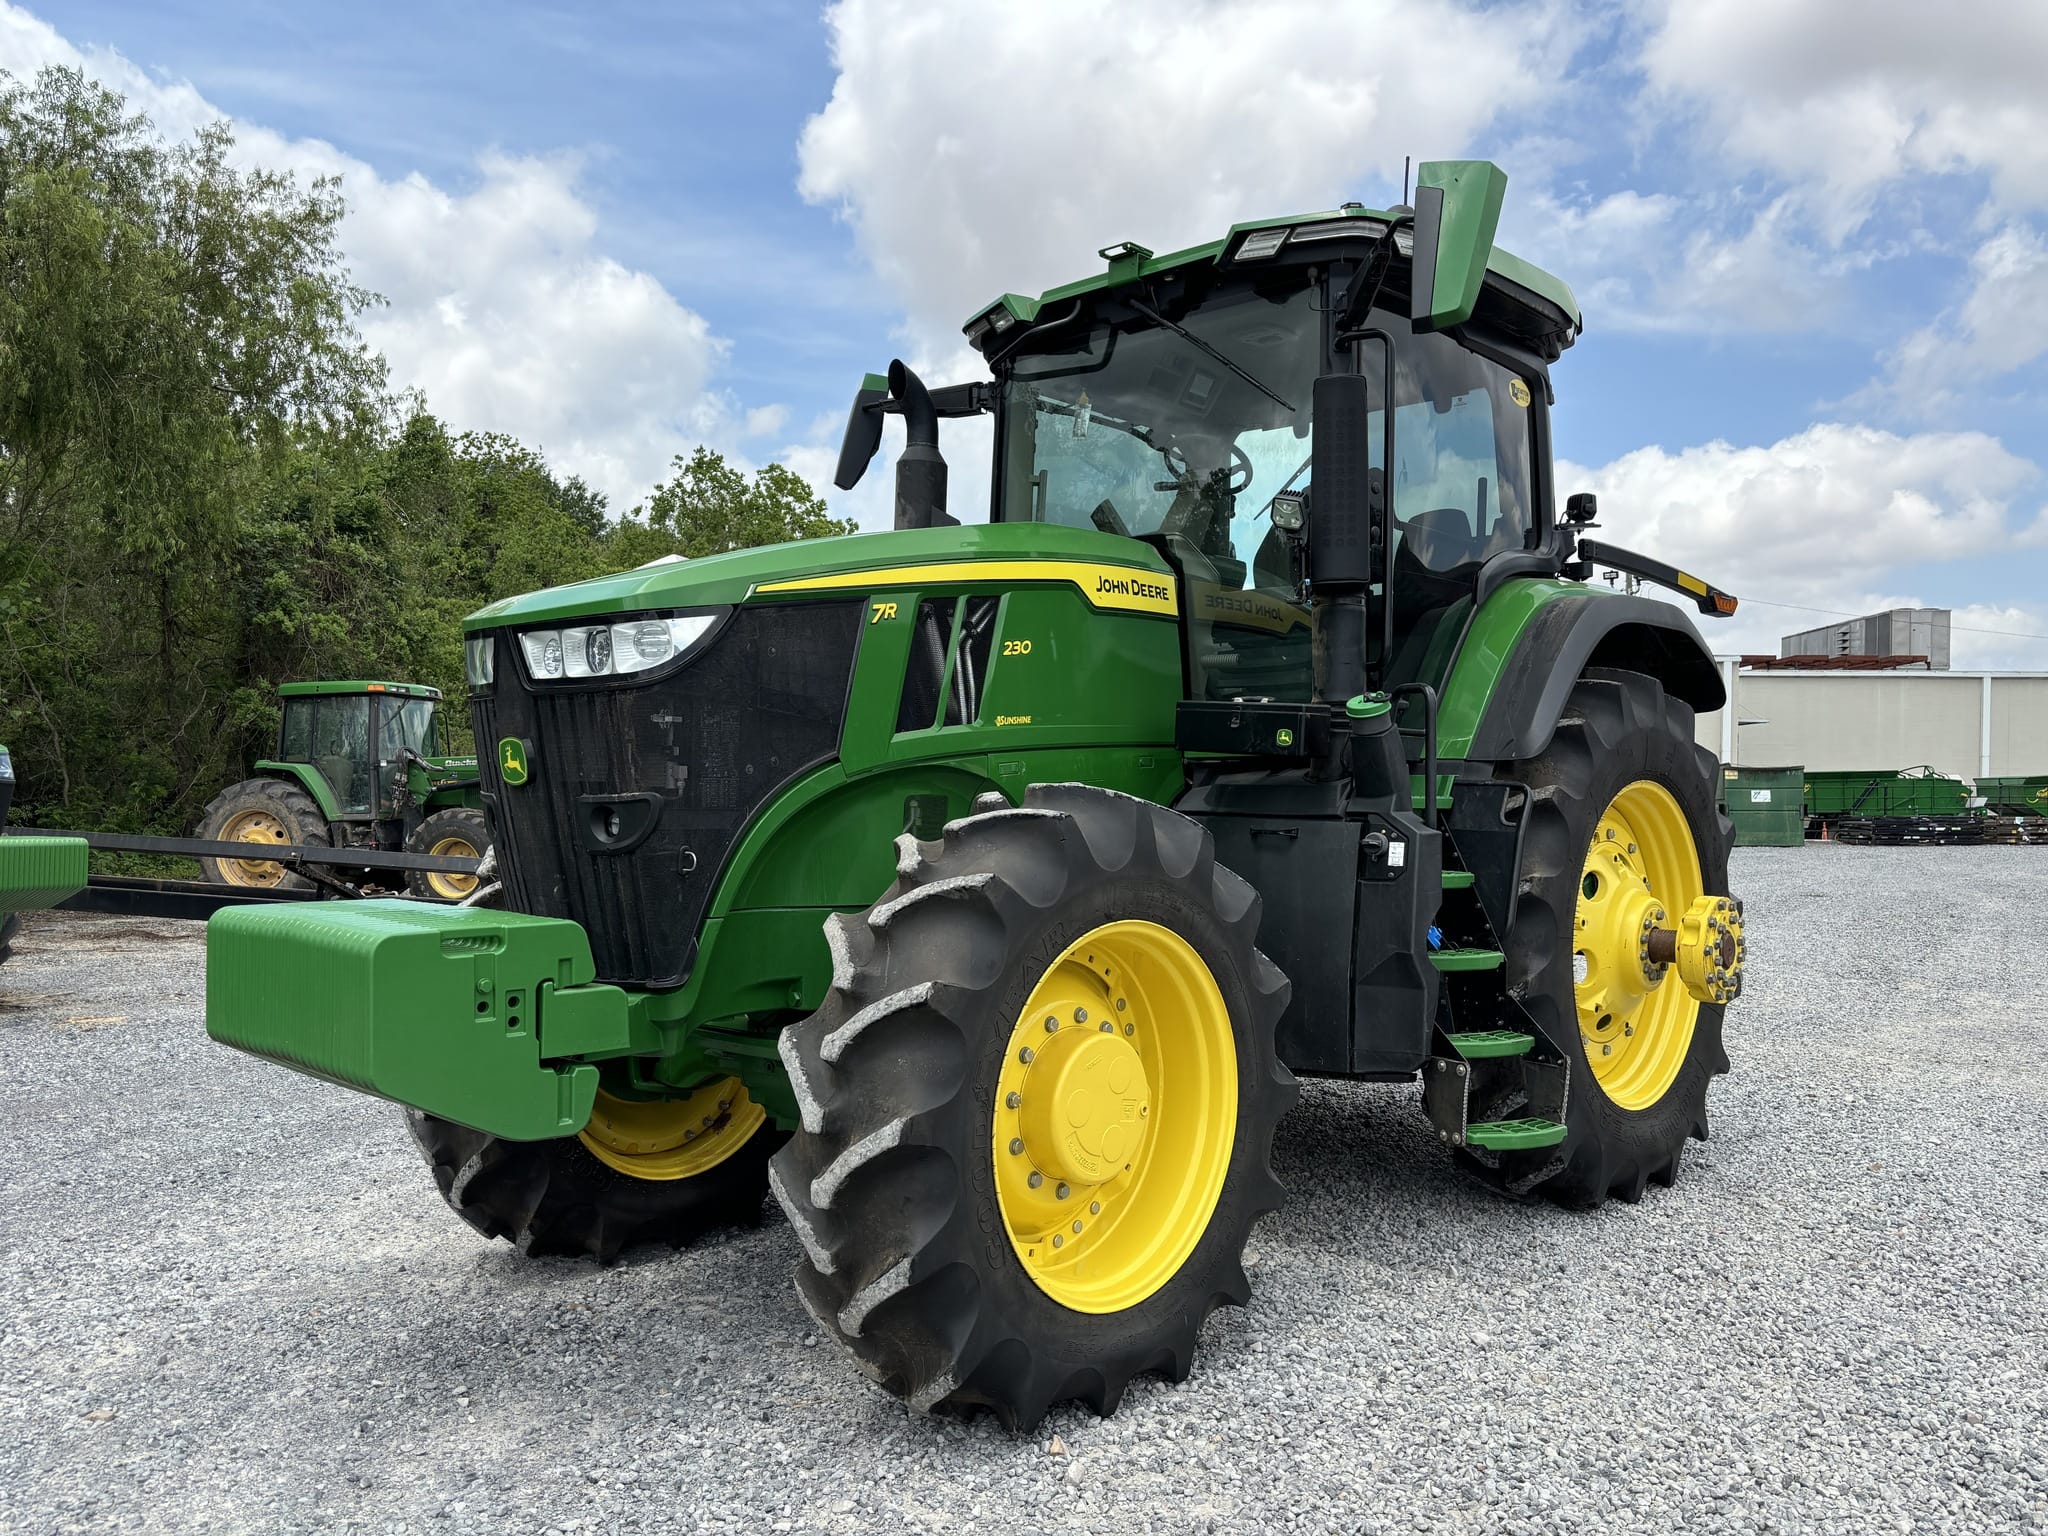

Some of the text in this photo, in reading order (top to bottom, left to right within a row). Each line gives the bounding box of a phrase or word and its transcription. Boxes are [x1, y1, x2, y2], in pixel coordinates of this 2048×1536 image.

[1096, 575, 1169, 600] JOHN DEERE
[871, 602, 898, 624] 7R
[1003, 640, 1032, 656] 230
[1000, 715, 1032, 726] SUNSHINE
